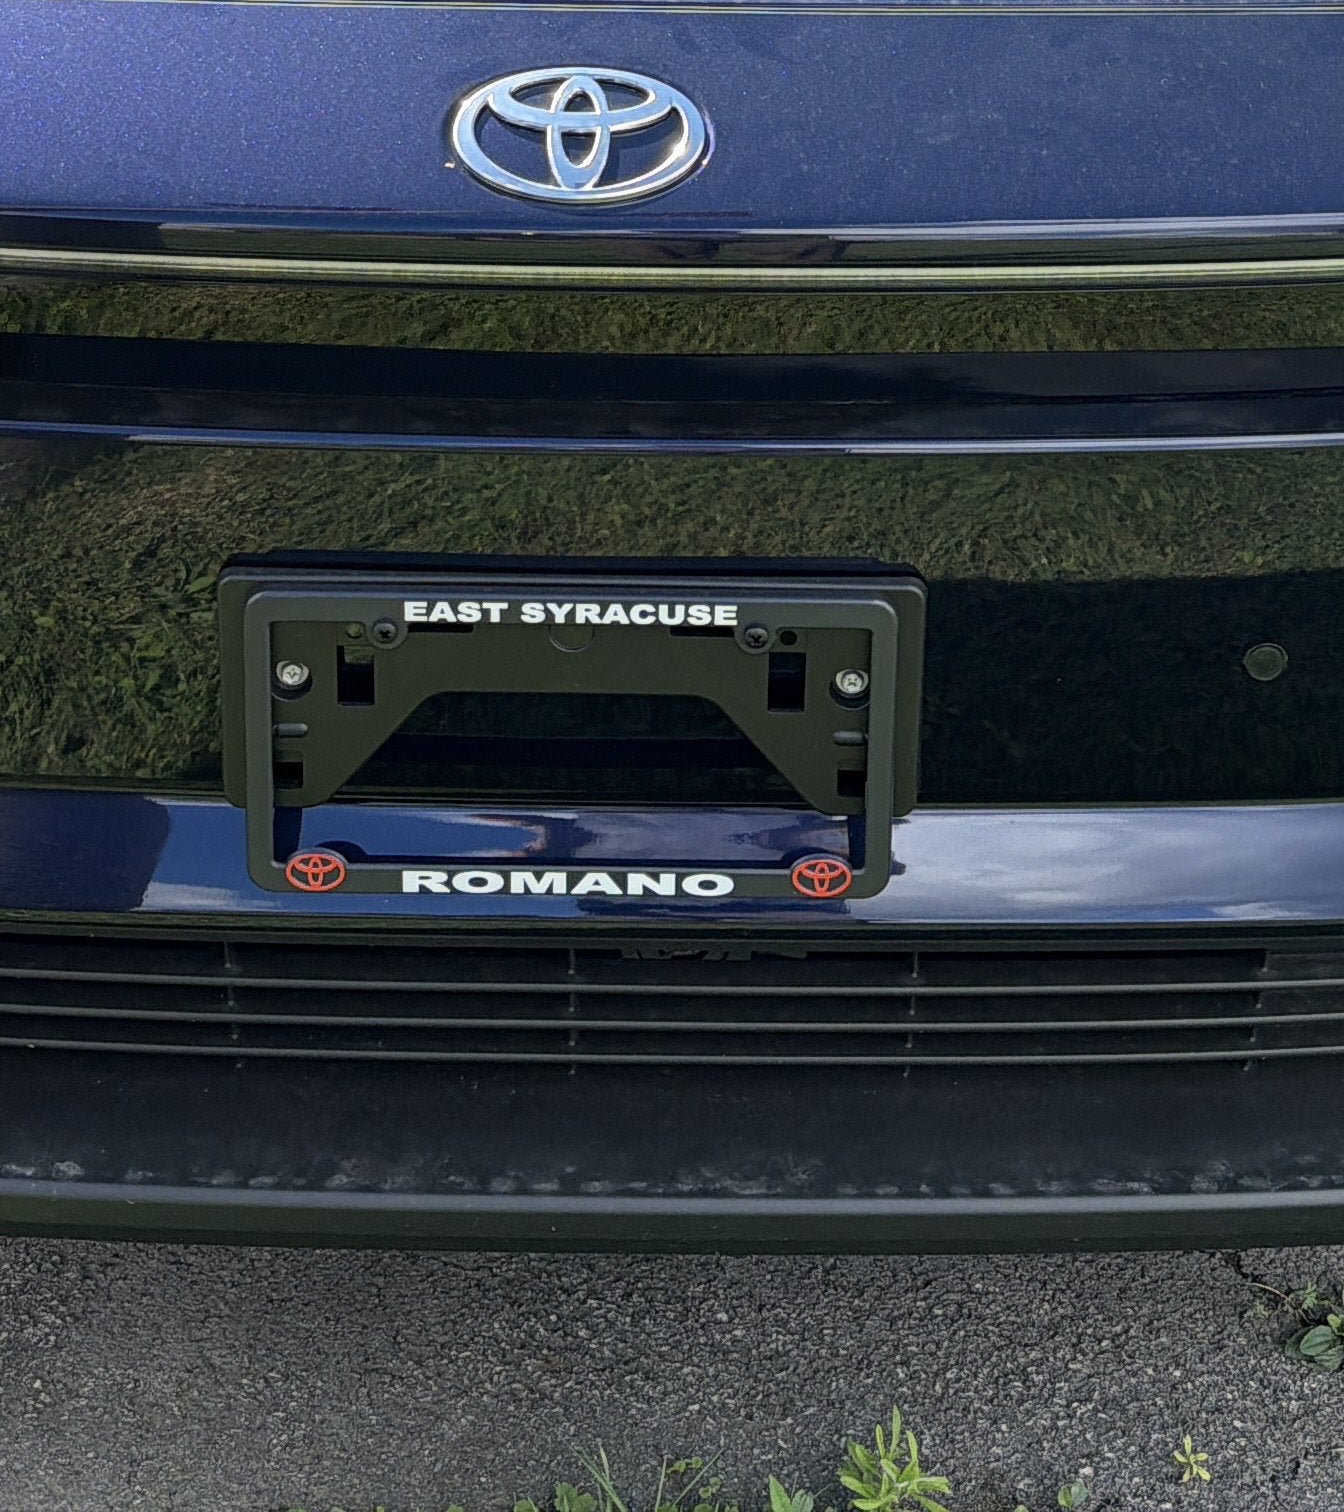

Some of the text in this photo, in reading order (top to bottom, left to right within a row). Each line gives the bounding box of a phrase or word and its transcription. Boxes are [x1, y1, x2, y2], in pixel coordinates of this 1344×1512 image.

[403, 601, 738, 627] EAST SYRACUSE
[401, 870, 734, 897] ROMANO
